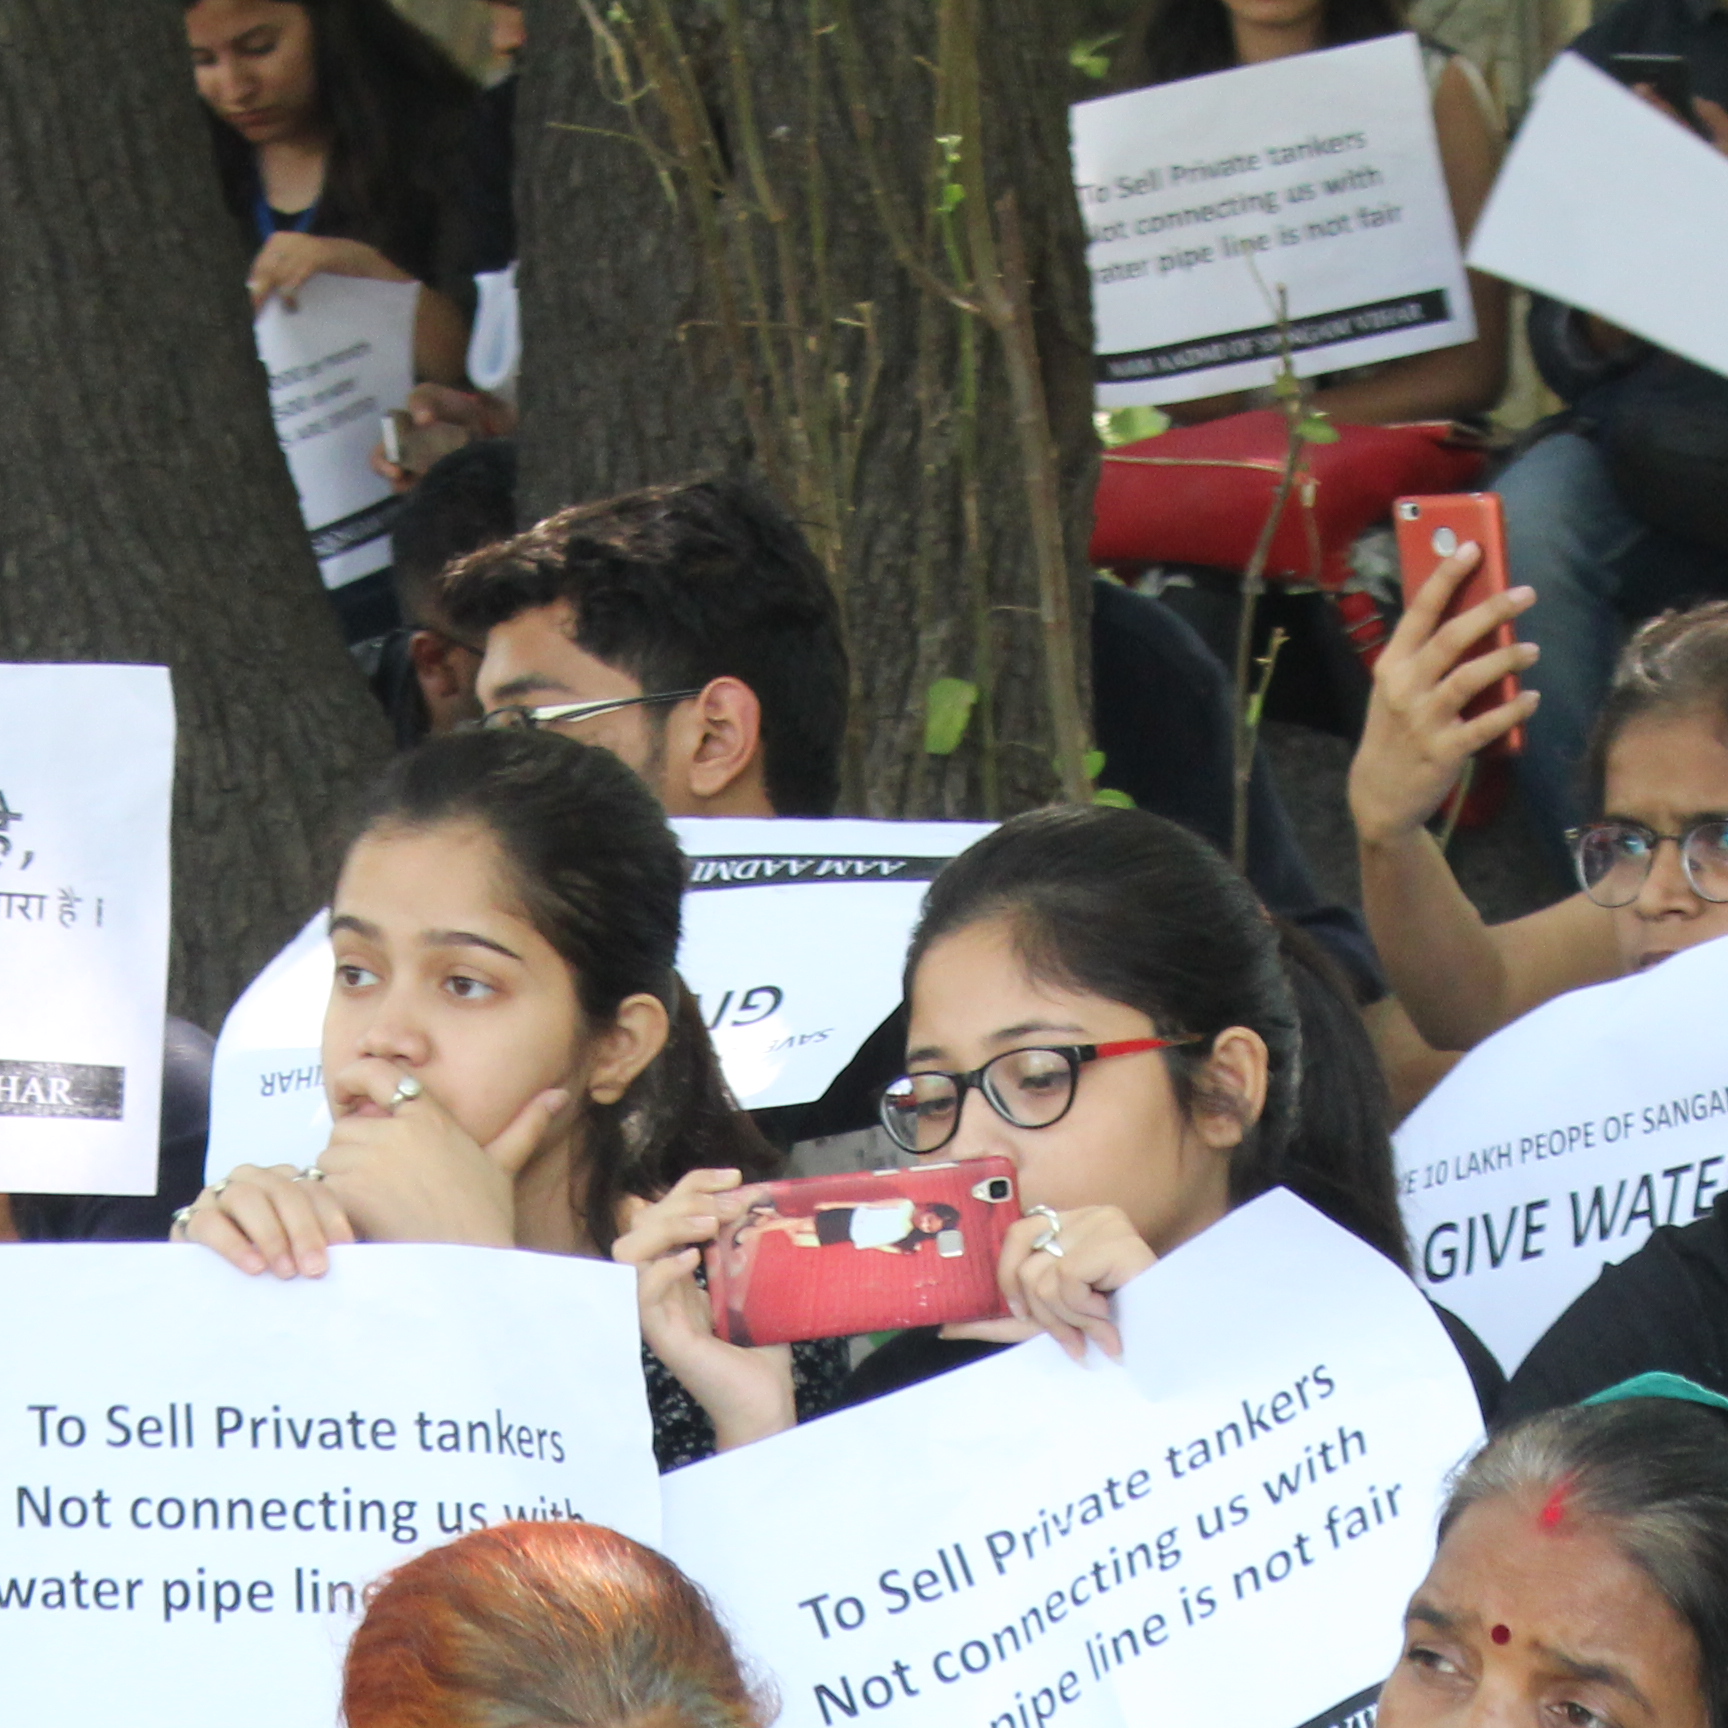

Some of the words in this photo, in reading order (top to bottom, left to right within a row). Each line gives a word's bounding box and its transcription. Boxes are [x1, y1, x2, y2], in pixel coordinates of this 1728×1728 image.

[1118, 168, 1162, 200] Sell
[1171, 150, 1261, 184] Private
[1268, 129, 1368, 167] tankers
[1134, 187, 1279, 233] connecting
[1286, 185, 1317, 205] us
[1323, 165, 1385, 195] with
[1094, 258, 1149, 285] ater
[1158, 243, 1214, 275] pipe
[1220, 231, 1270, 260] line
[1280, 224, 1301, 246] is
[1308, 215, 1353, 241] not
[1358, 200, 1403, 227] fair
[259, 1063, 324, 1097] IHAR
[1423, 1159, 1449, 1190] 10
[1454, 1142, 1514, 1182] LAKH
[1519, 1121, 1597, 1165] PEOPE
[1602, 1110, 1637, 1144] OF
[1422, 1198, 1551, 1286] GIVE
[28, 1403, 86, 1449] To
[105, 1402, 194, 1449] Sell
[215, 1404, 398, 1451] Private
[415, 1408, 567, 1464] tankers
[15, 1484, 112, 1530] Not
[129, 1486, 419, 1543] connecting
[436, 1503, 490, 1535] us
[798, 1595, 867, 1641] To
[879, 1543, 976, 1617] Sell
[984, 1466, 1152, 1577] Private
[1164, 1360, 1337, 1480] tankers
[162, 1567, 275, 1623] pipe
[812, 1656, 921, 1726] Not
[932, 1525, 1181, 1686] connecting
[1197, 1496, 1251, 1541] us
[1261, 1423, 1369, 1503] with
[1085, 1612, 1170, 1682] line
[1183, 1580, 1217, 1627] is
[1232, 1532, 1316, 1601] not
[1322, 1478, 1404, 1551] fair
